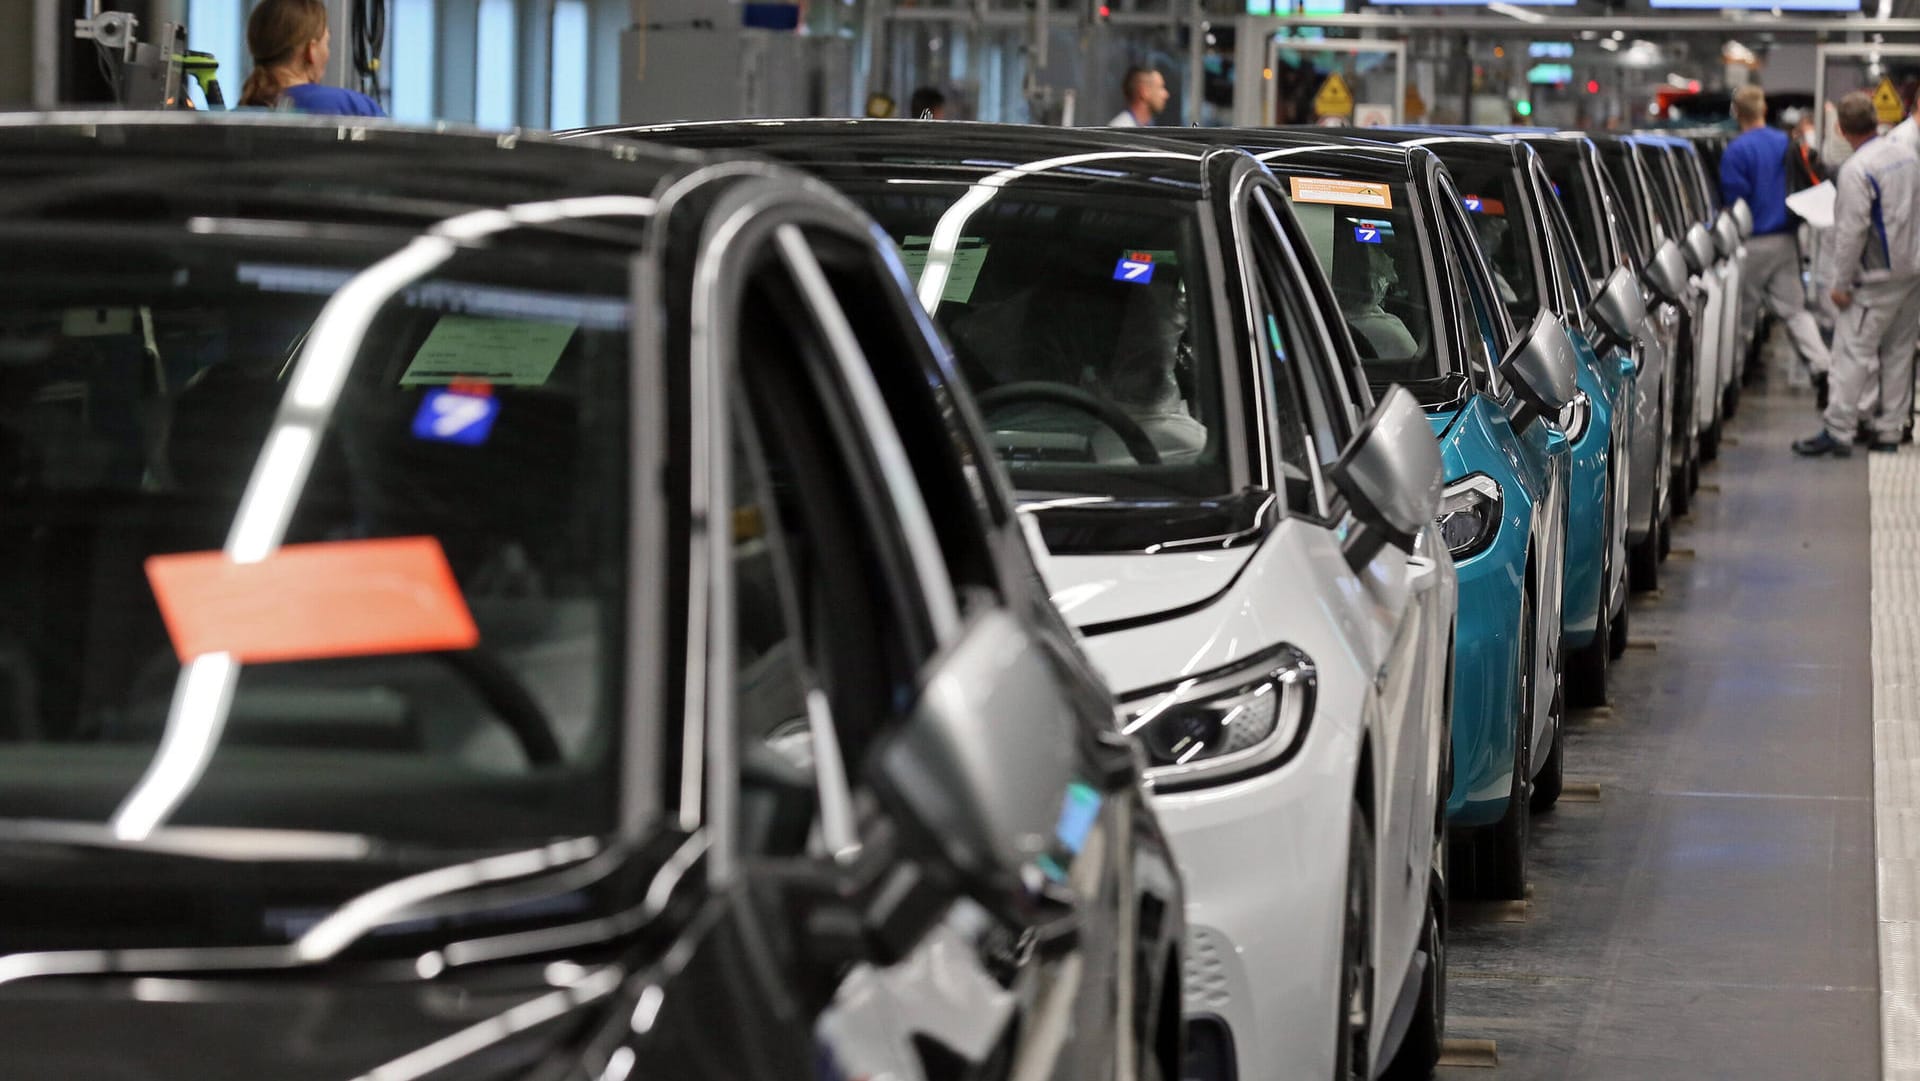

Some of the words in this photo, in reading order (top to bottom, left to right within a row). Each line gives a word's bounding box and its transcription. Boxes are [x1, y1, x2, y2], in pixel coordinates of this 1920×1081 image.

[1358, 229, 1376, 241] 7
[1123, 261, 1150, 279] 7
[432, 393, 490, 437] 7
